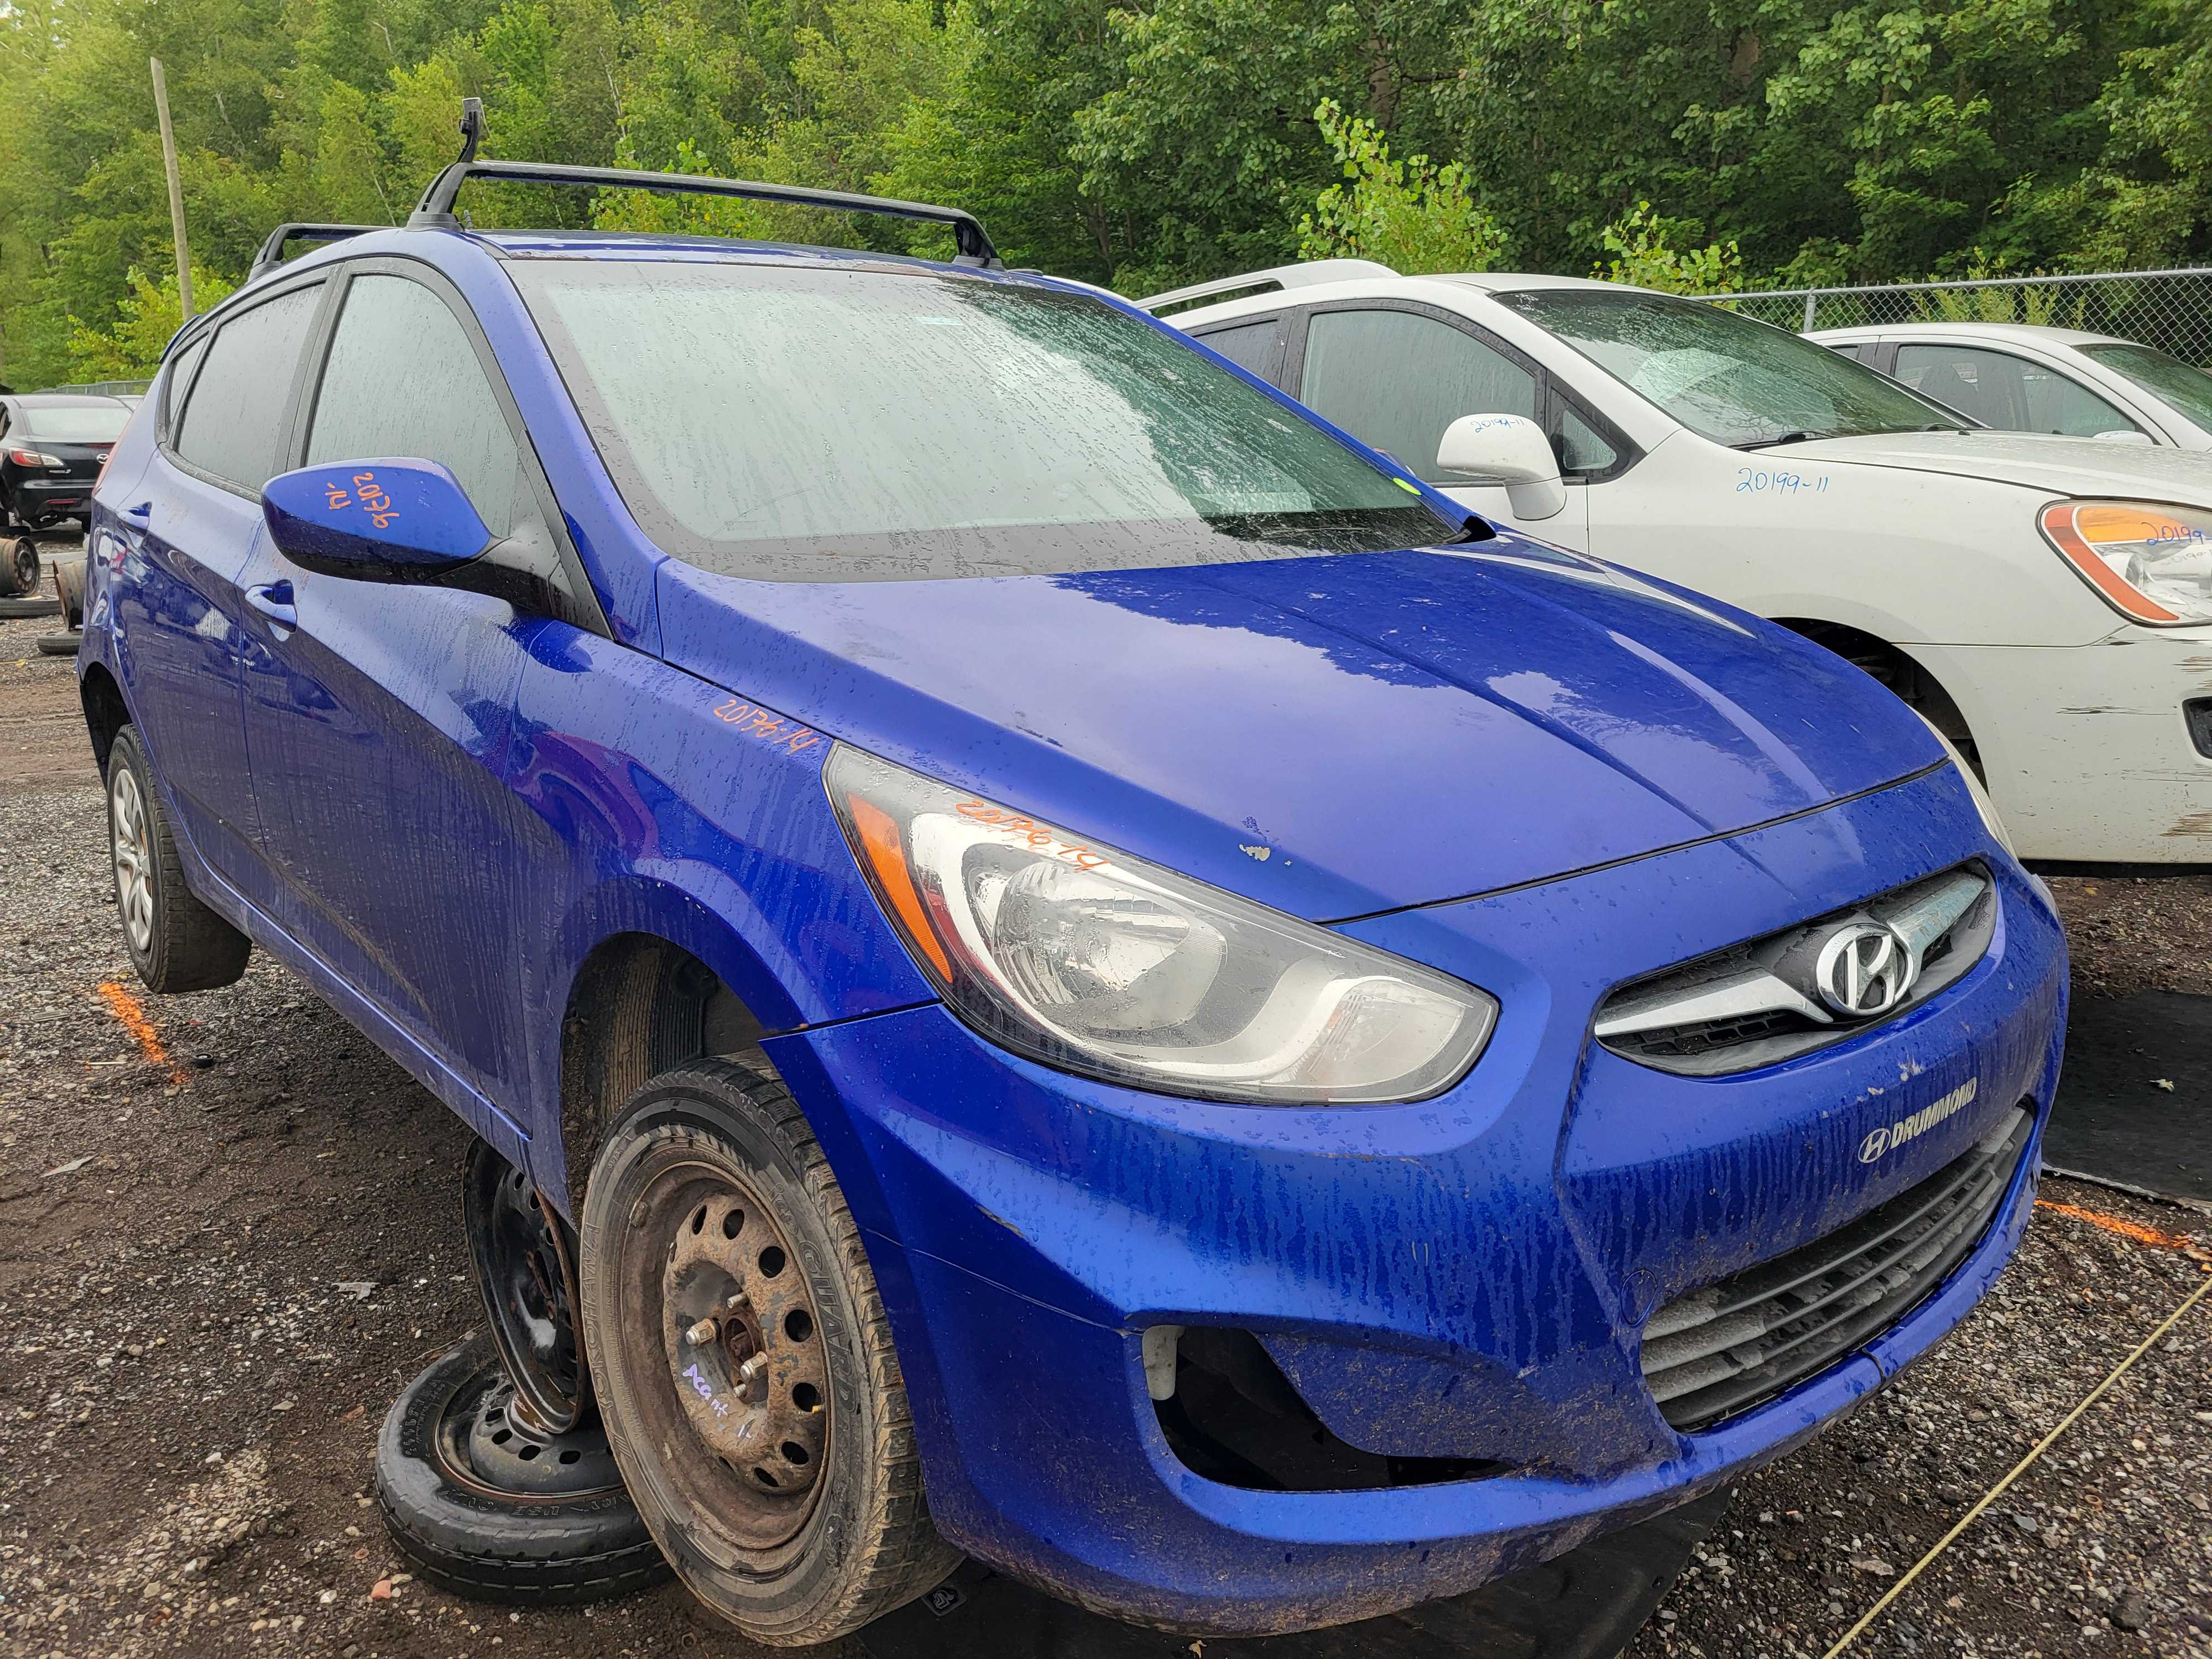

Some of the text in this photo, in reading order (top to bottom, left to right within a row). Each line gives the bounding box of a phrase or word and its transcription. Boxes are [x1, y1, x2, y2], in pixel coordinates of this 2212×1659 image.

[352, 472, 400, 529] 20176
[1736, 467, 1829, 495] 20199-11
[1890, 1076, 1978, 1149] DRUMMOND
[581, 1222, 615, 1413] YOKOHAMA
